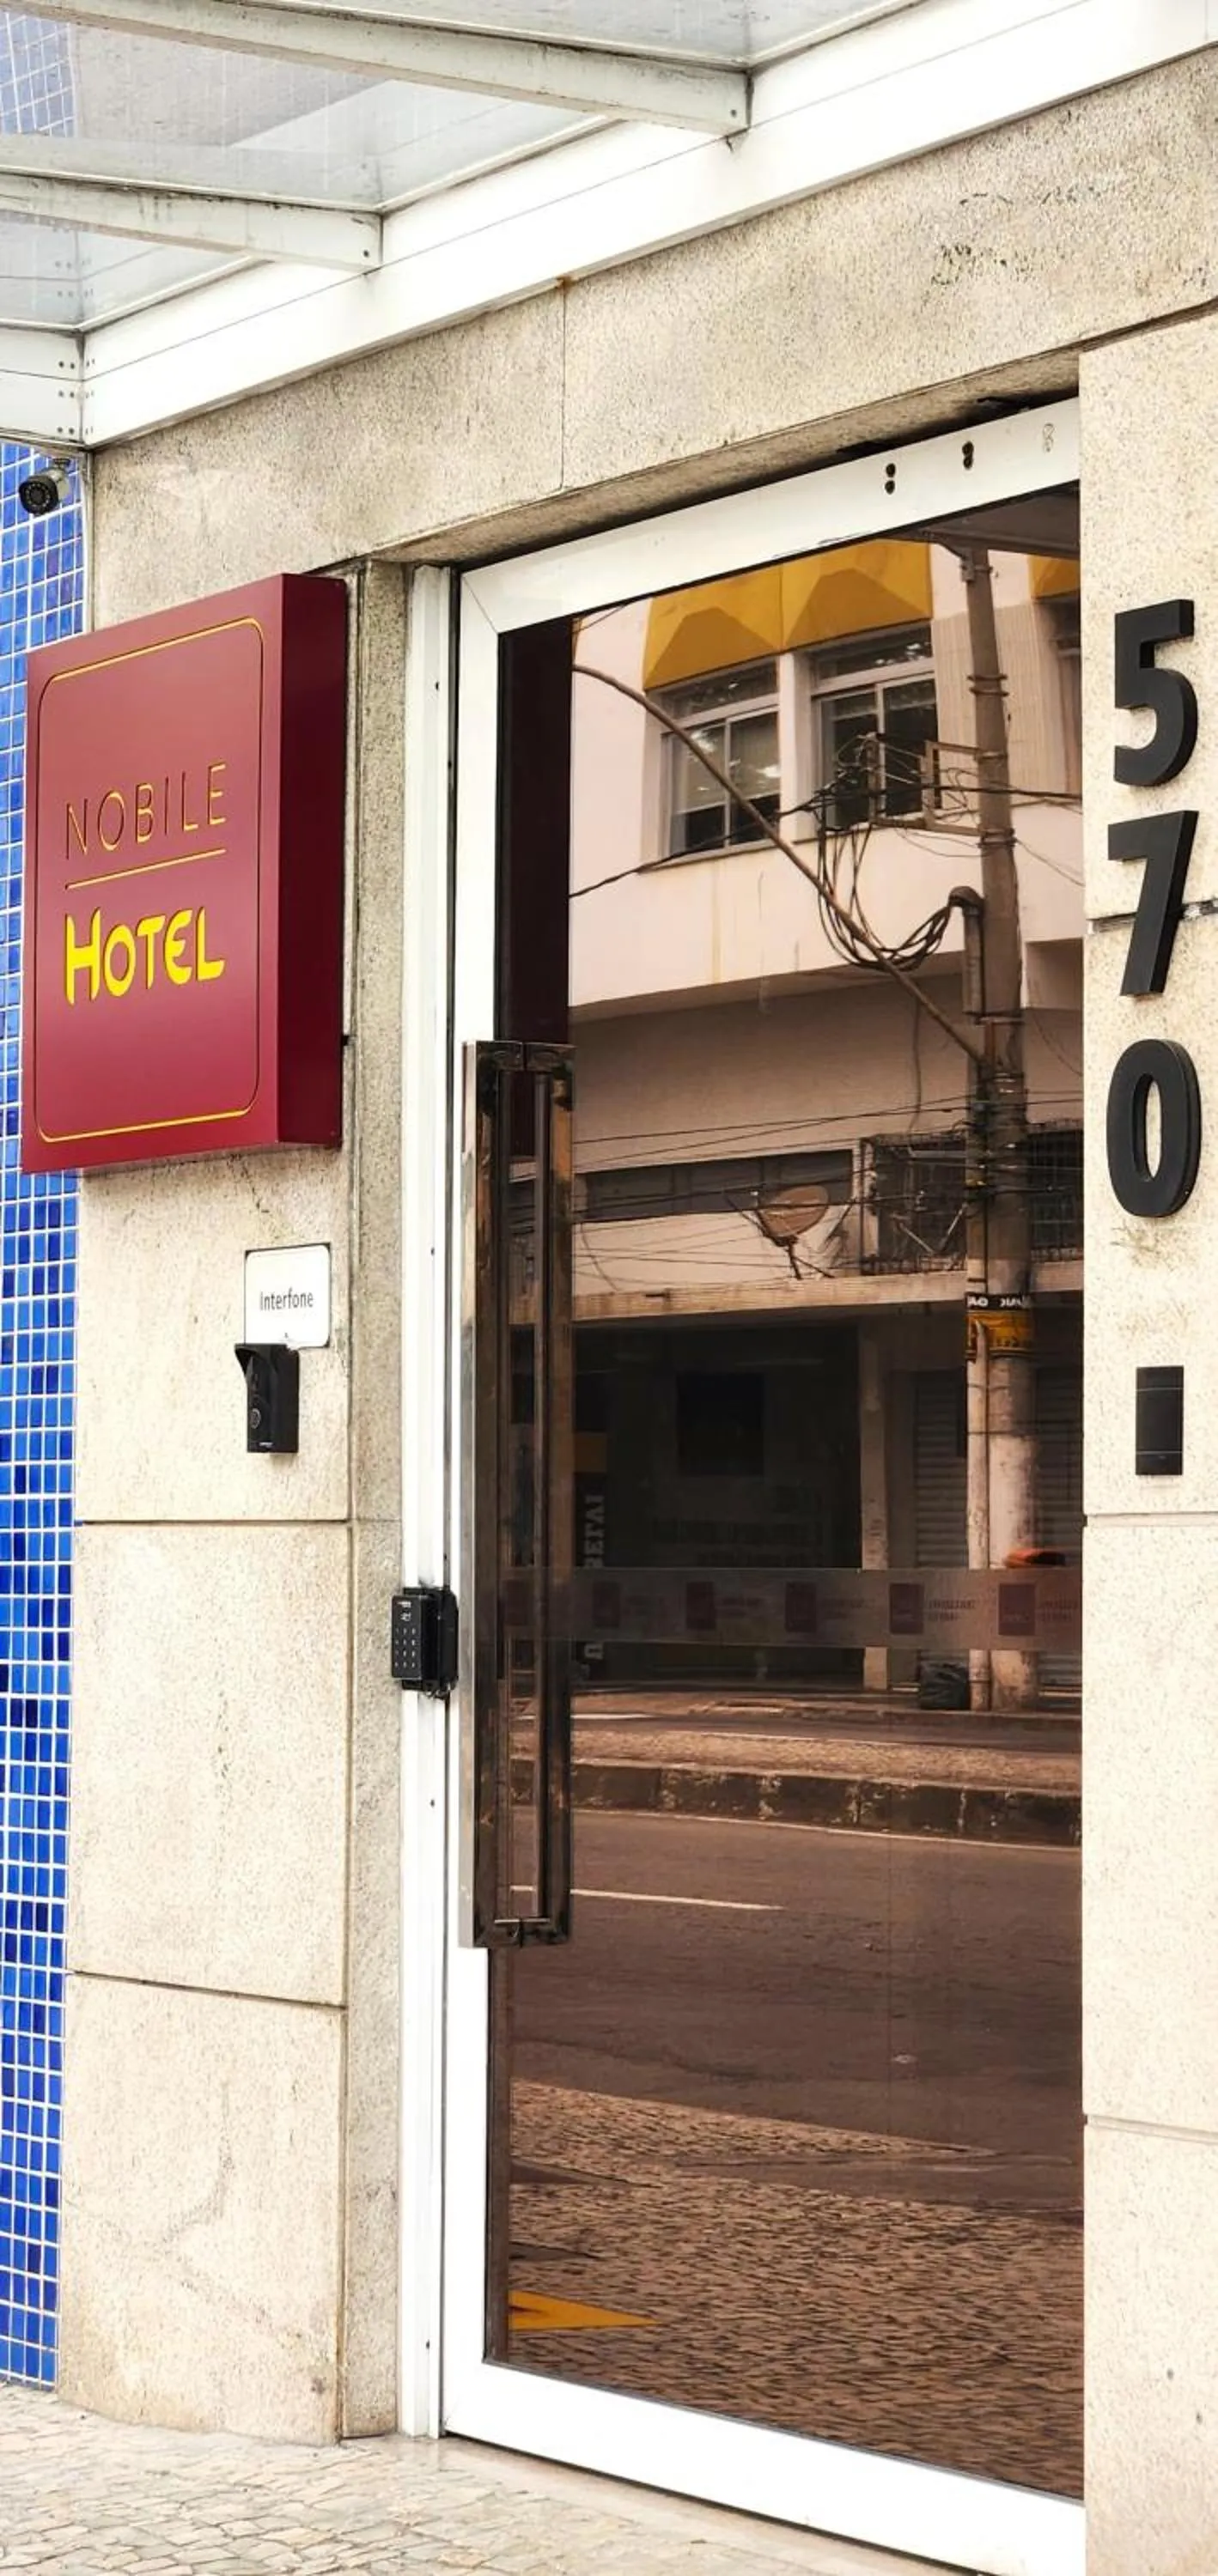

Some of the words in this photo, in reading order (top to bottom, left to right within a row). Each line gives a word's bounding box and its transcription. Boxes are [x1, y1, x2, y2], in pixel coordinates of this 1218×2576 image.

[66, 762, 226, 860] NOBILE
[64, 907, 225, 1005] HOTEL
[1106, 598, 1202, 1218] 570
[259, 1287, 314, 1311] Interfone
